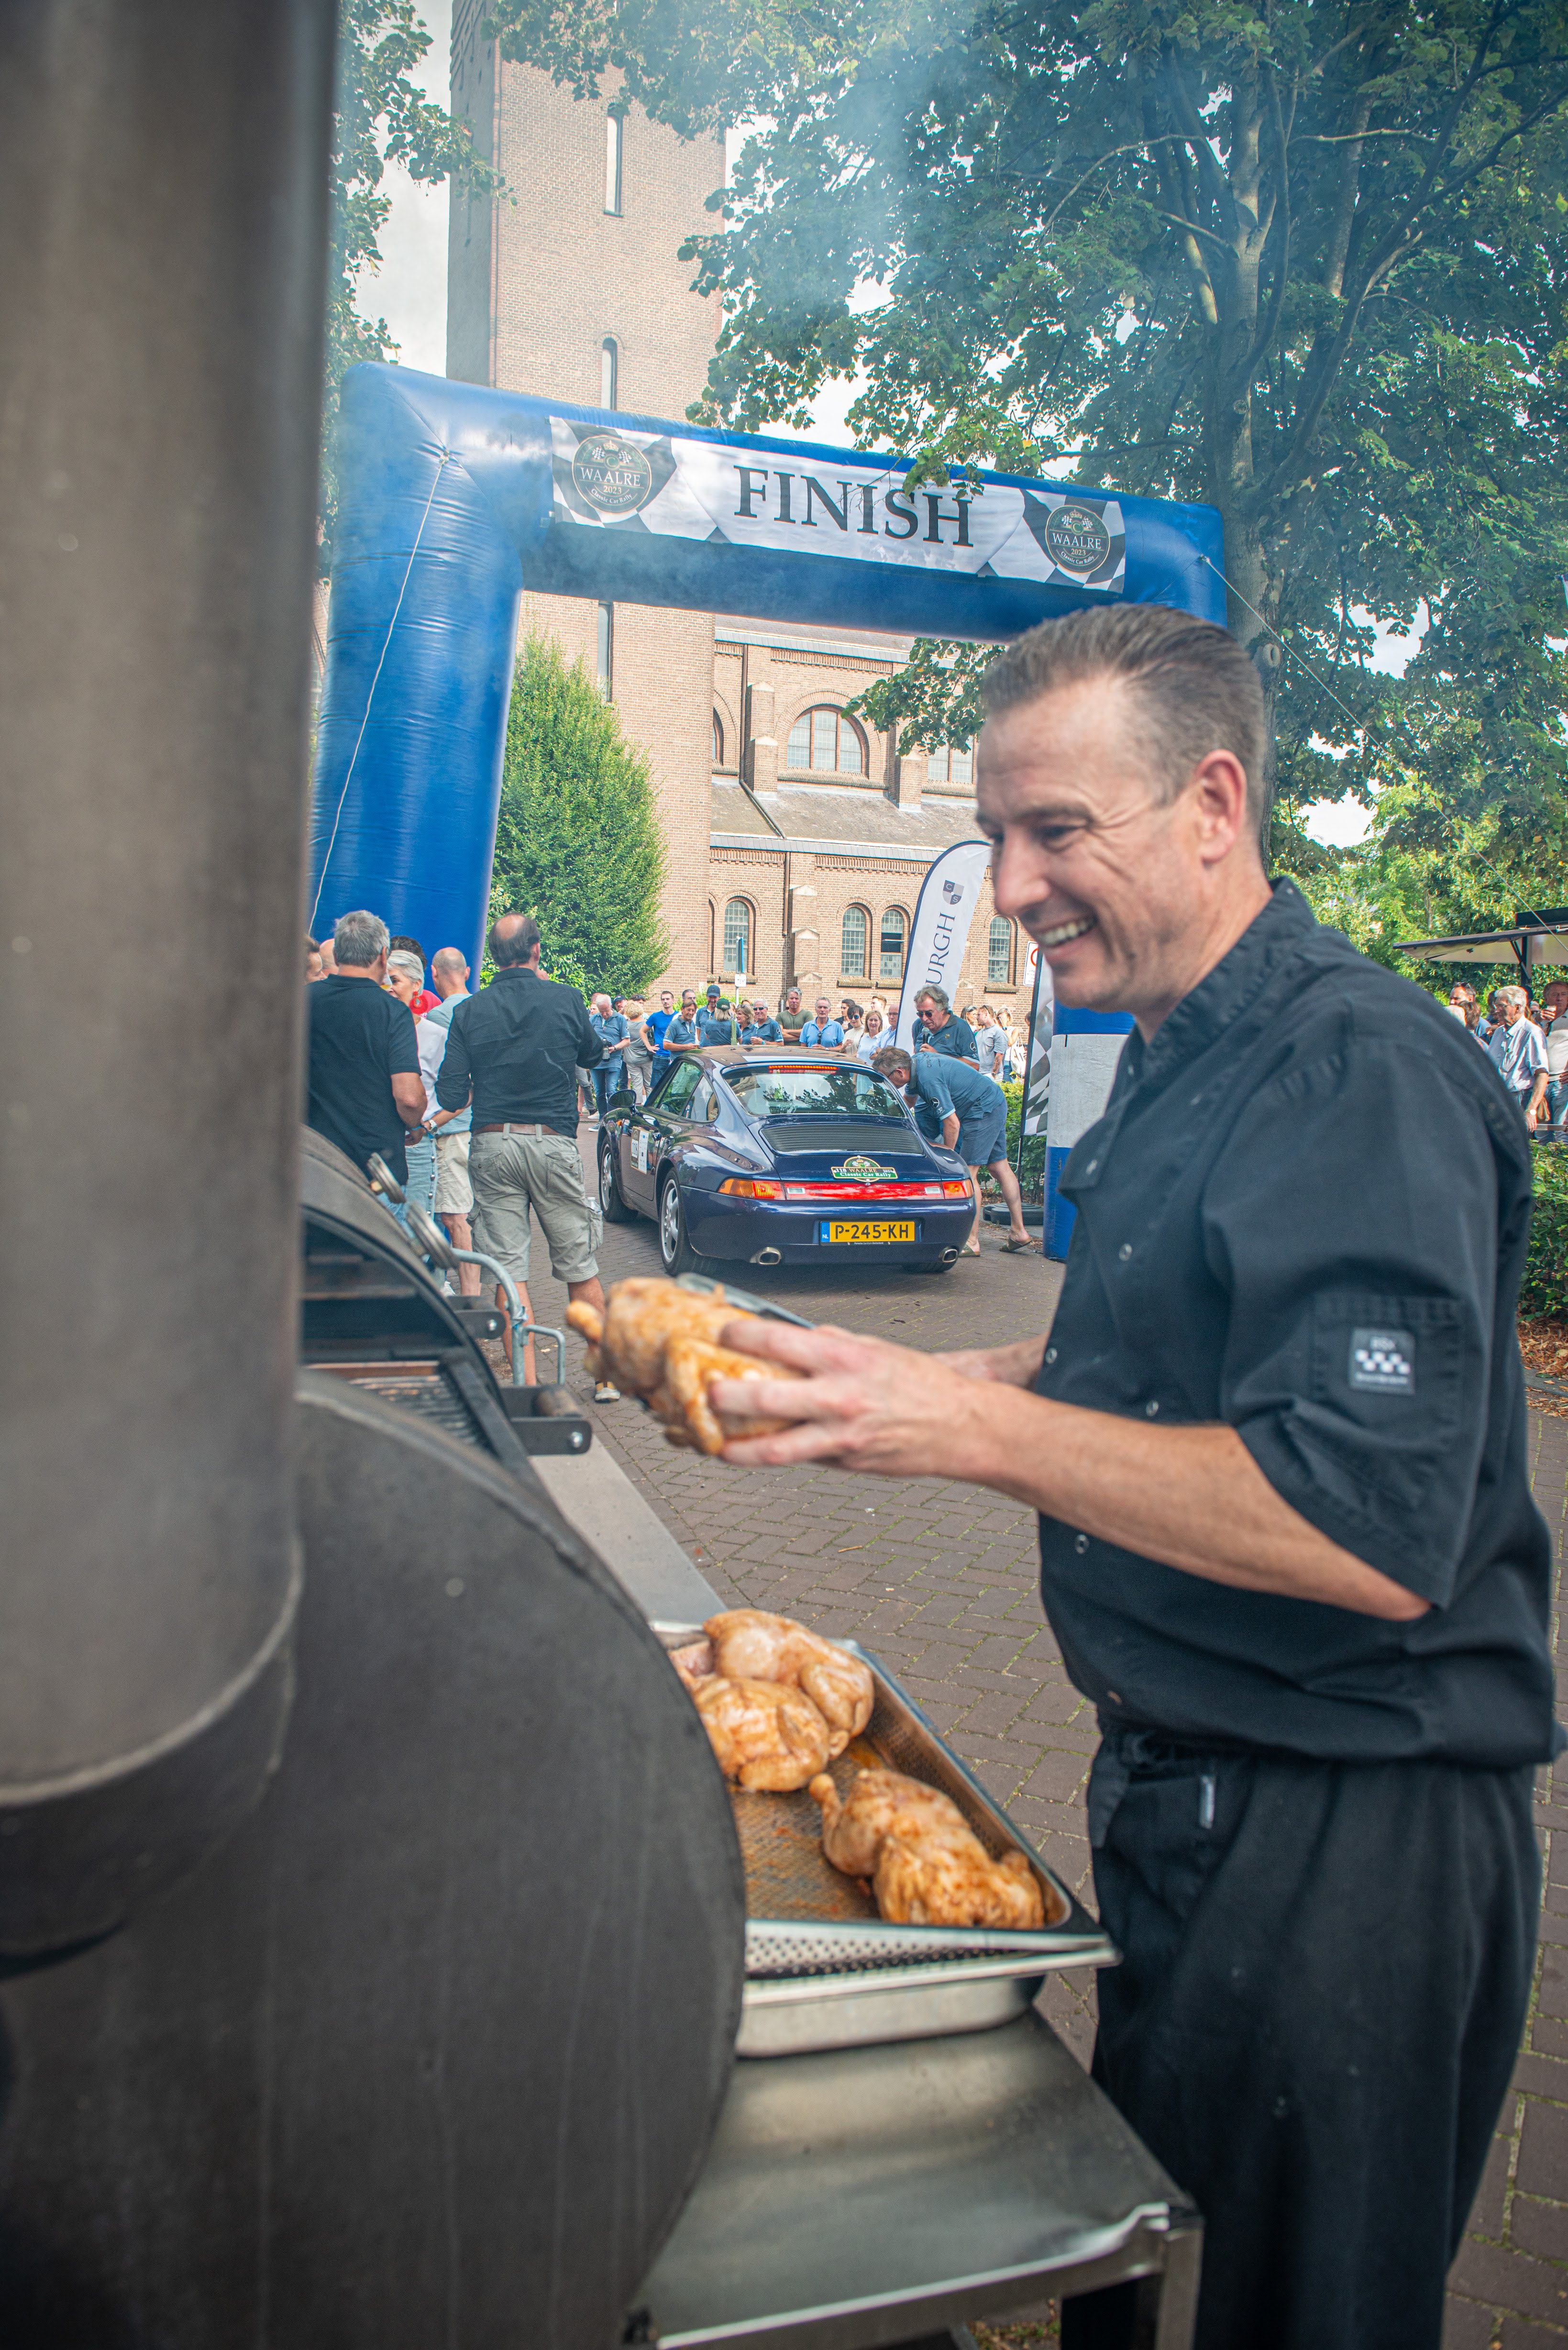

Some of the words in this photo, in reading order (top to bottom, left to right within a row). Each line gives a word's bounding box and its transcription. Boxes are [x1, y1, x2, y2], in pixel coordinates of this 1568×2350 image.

[580, 467, 640, 487] WAALRE
[591, 488, 608, 503] Classic
[619, 493, 632, 503] Rally
[603, 485, 622, 495] 2023
[733, 465, 974, 548] FINISH
[1052, 532, 1102, 550] WAALRE
[1060, 551, 1075, 564] Classic
[1084, 555, 1094, 564] Rally
[1071, 548, 1086, 556] 2023
[835, 1224, 908, 1239] P-245-KH
